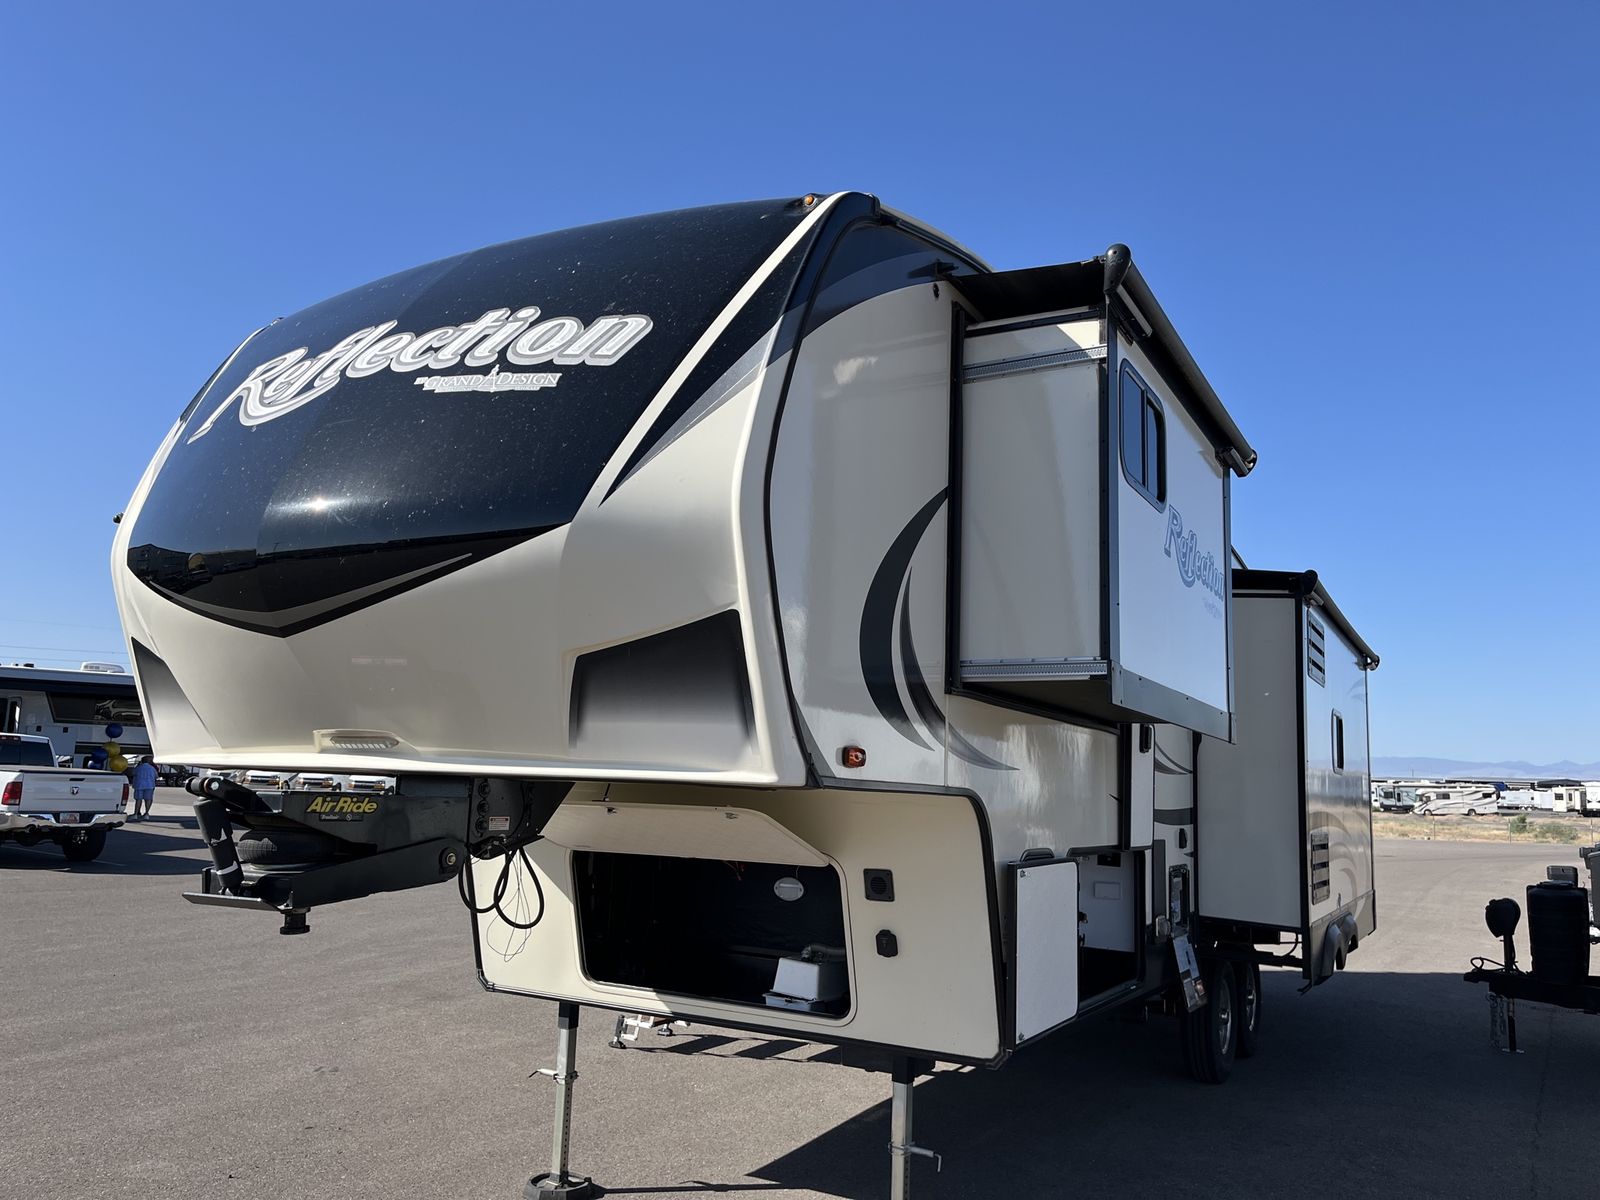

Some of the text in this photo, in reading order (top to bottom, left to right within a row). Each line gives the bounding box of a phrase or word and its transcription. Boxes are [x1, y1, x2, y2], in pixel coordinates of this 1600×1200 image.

[187, 306, 654, 444] Reflection
[423, 375, 484, 389] GRAND
[496, 372, 562, 387] DESIGN
